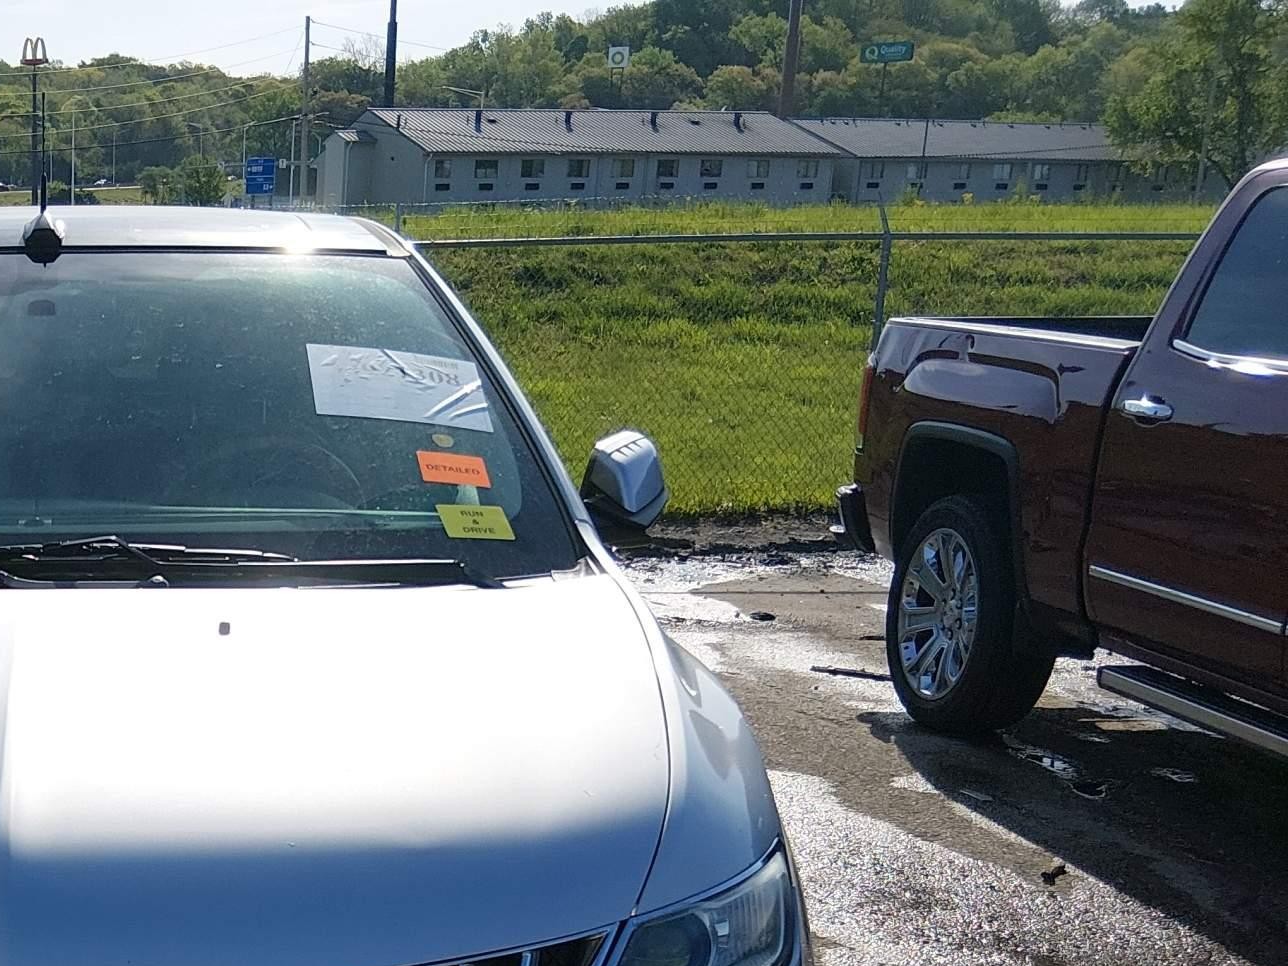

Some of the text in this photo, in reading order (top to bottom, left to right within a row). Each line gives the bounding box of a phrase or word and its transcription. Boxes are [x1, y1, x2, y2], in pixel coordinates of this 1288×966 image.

[881, 44, 905, 55] Quality
[425, 463, 481, 476] DETAILED
[462, 526, 496, 534] DRIVE
